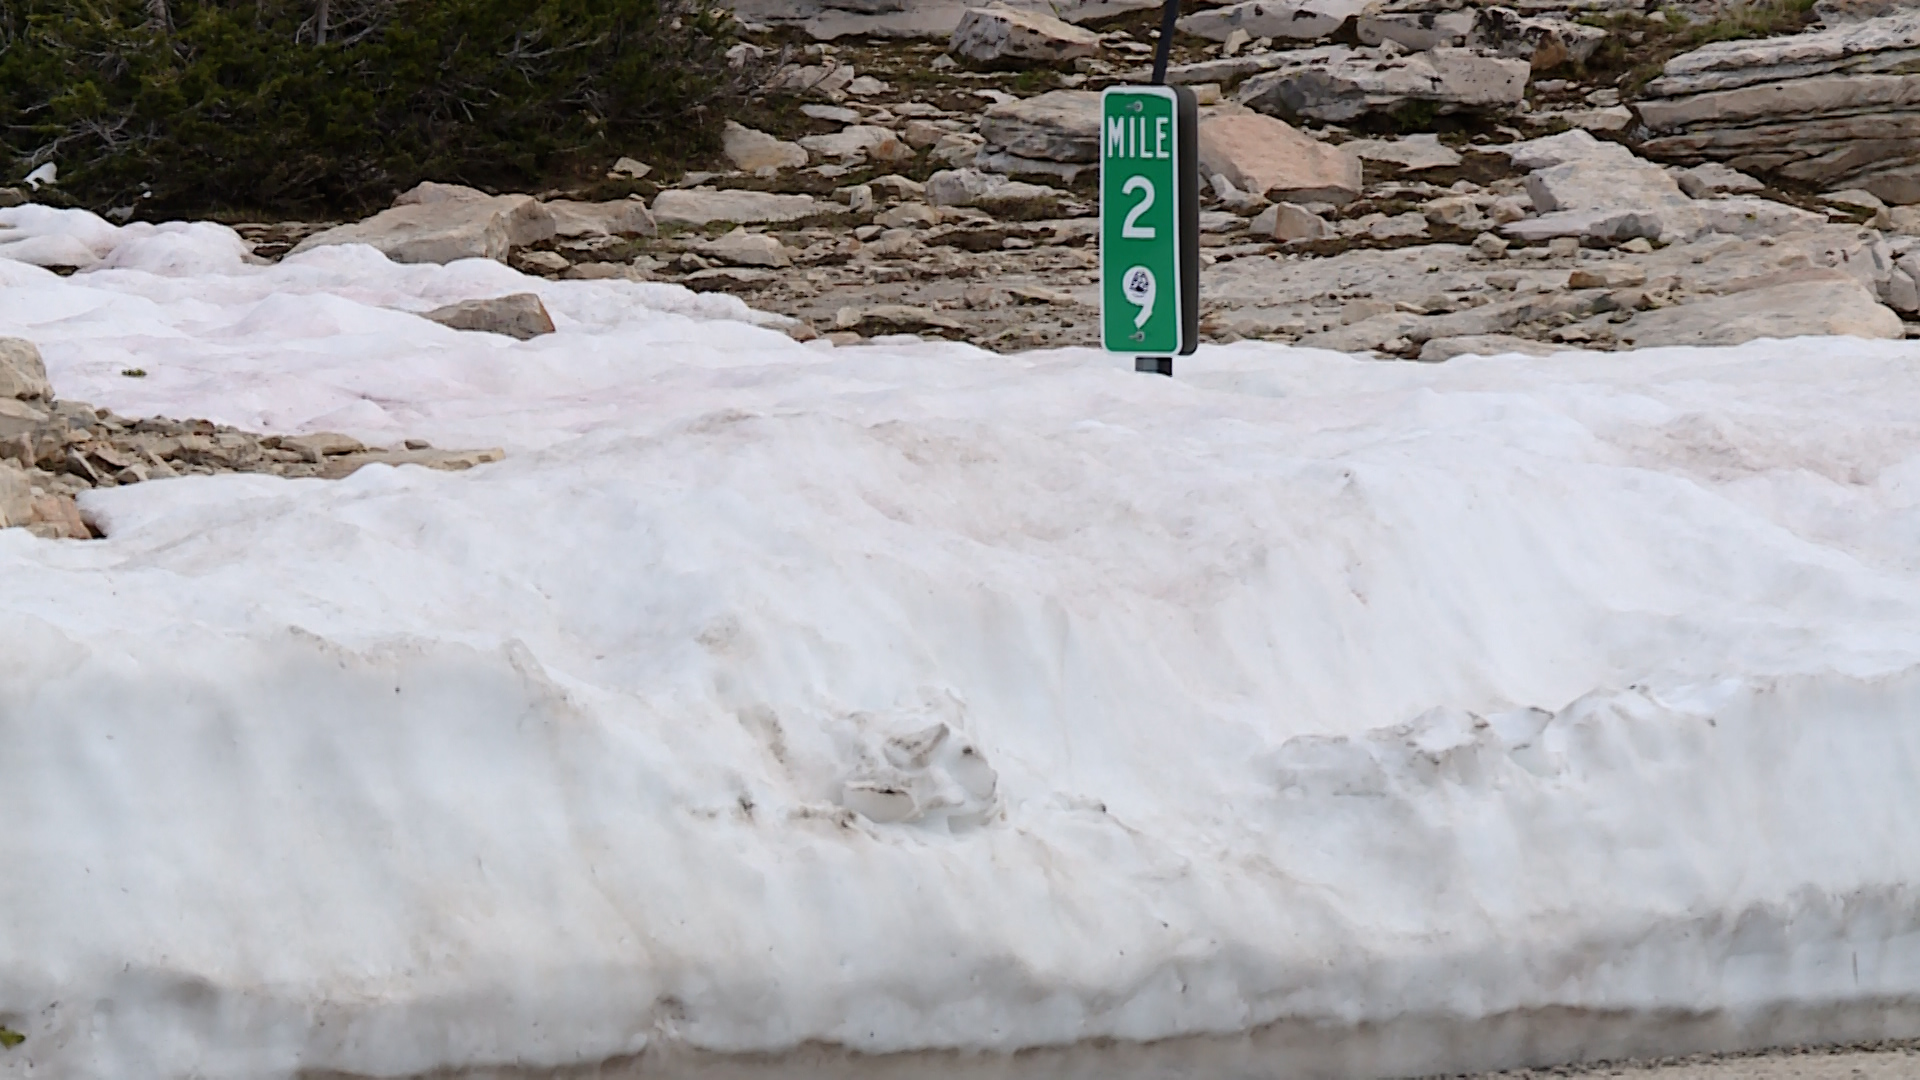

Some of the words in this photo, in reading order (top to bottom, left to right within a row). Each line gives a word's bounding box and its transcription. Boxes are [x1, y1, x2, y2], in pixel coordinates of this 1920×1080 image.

[1107, 116, 1170, 159] MILE
[1121, 175, 1156, 239] 2
[1122, 265, 1156, 329] 9
